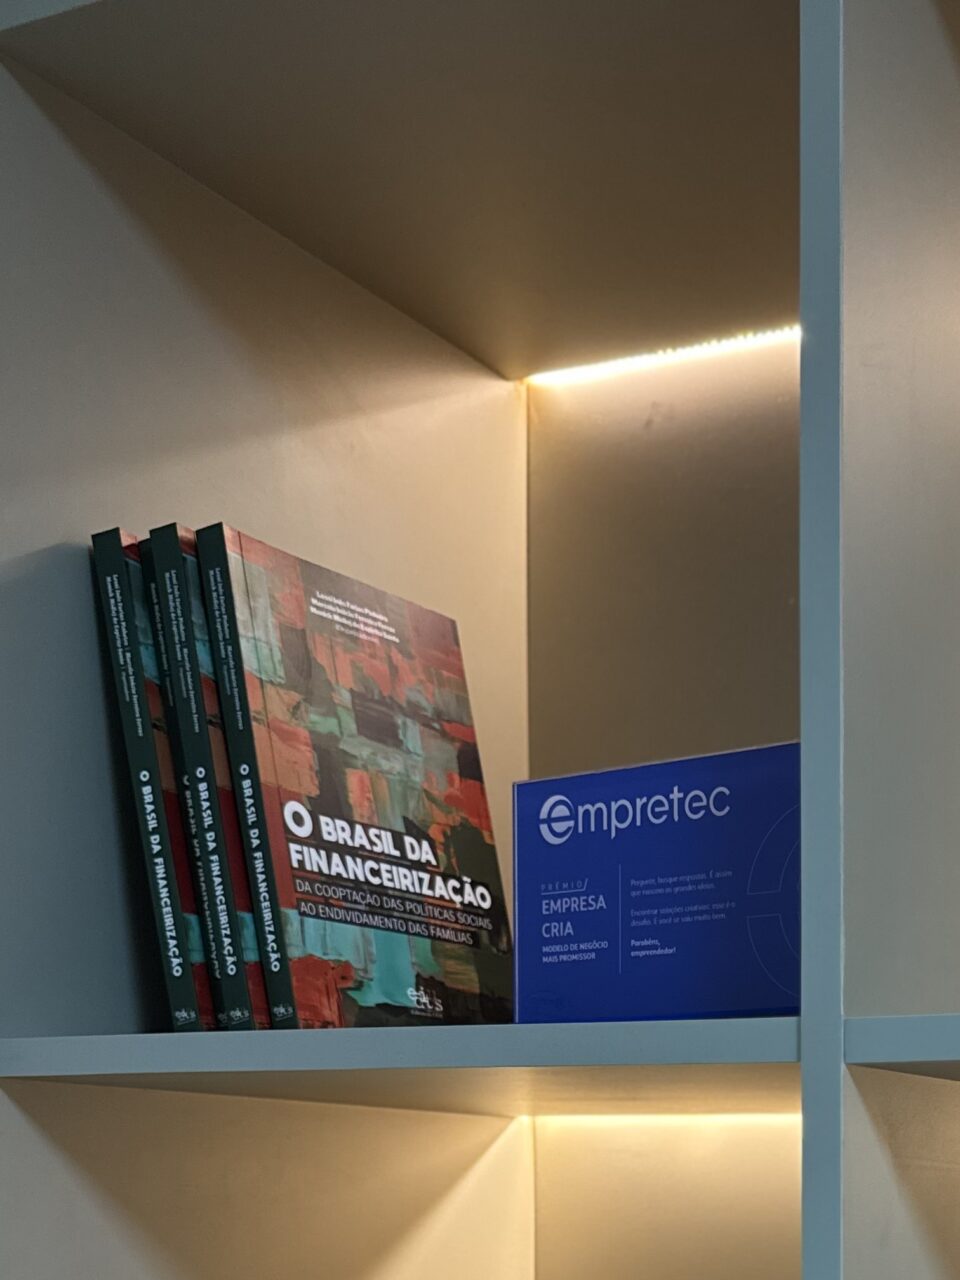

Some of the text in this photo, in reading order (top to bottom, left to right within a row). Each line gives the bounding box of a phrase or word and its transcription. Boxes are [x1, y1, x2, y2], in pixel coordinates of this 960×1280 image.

[195, 767, 206, 779] O
[196, 781, 215, 829] BRASIL
[539, 785, 731, 845] empretec
[205, 831, 217, 852] DA
[284, 800, 437, 866] O BRASIL DA
[139, 770, 183, 977] O BRASIL DA FINANCEIRIZAÇÃO
[239, 763, 281, 972] O BRASIL DA FINANCEIRIZAÇÃO
[288, 842, 493, 910] FINANCEIRIZAÇÃO
[208, 854, 237, 976] FINANCEIRIZAÇÃO
[295, 879, 493, 930] DA COOPTAÇÃO DAS POLÍTICAS SOCIAIS
[300, 902, 474, 945] AO ENDIVIDAMENTO DAS FAMÍLIAS
[542, 894, 607, 915] EMPRESA
[542, 921, 574, 938] CRIA
[542, 944, 569, 953] MODELO
[570, 943, 579, 951] DE
